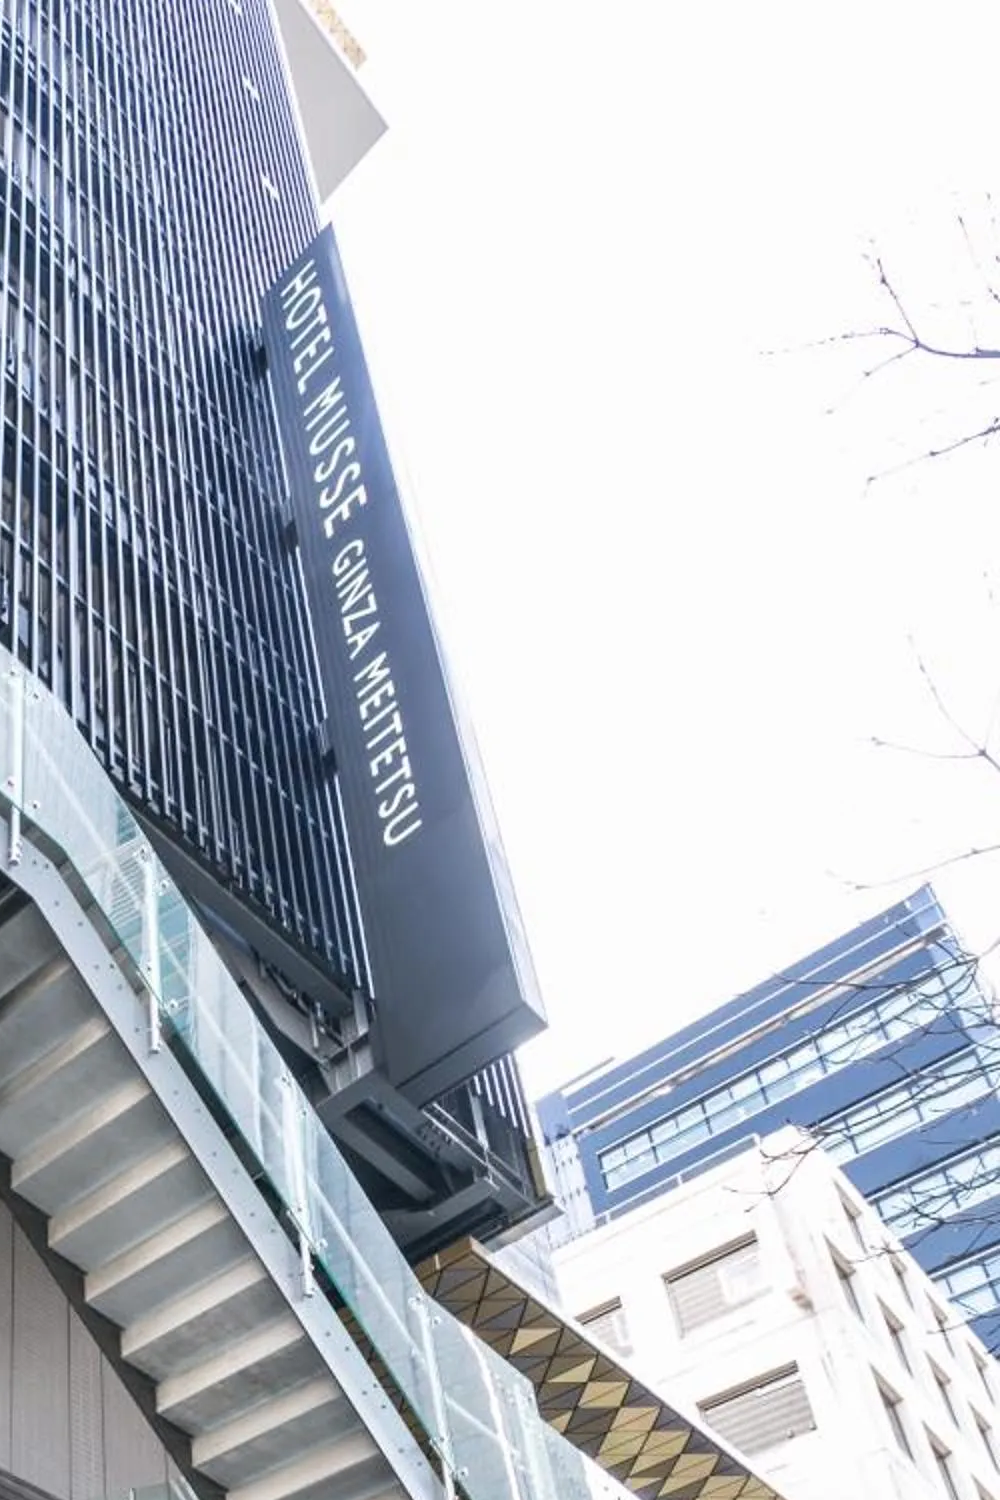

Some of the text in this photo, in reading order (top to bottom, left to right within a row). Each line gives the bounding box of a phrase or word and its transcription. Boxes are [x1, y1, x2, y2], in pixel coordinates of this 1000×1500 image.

[280, 259, 423, 846] HOTEL MUSSE GINZA MEITETSU
